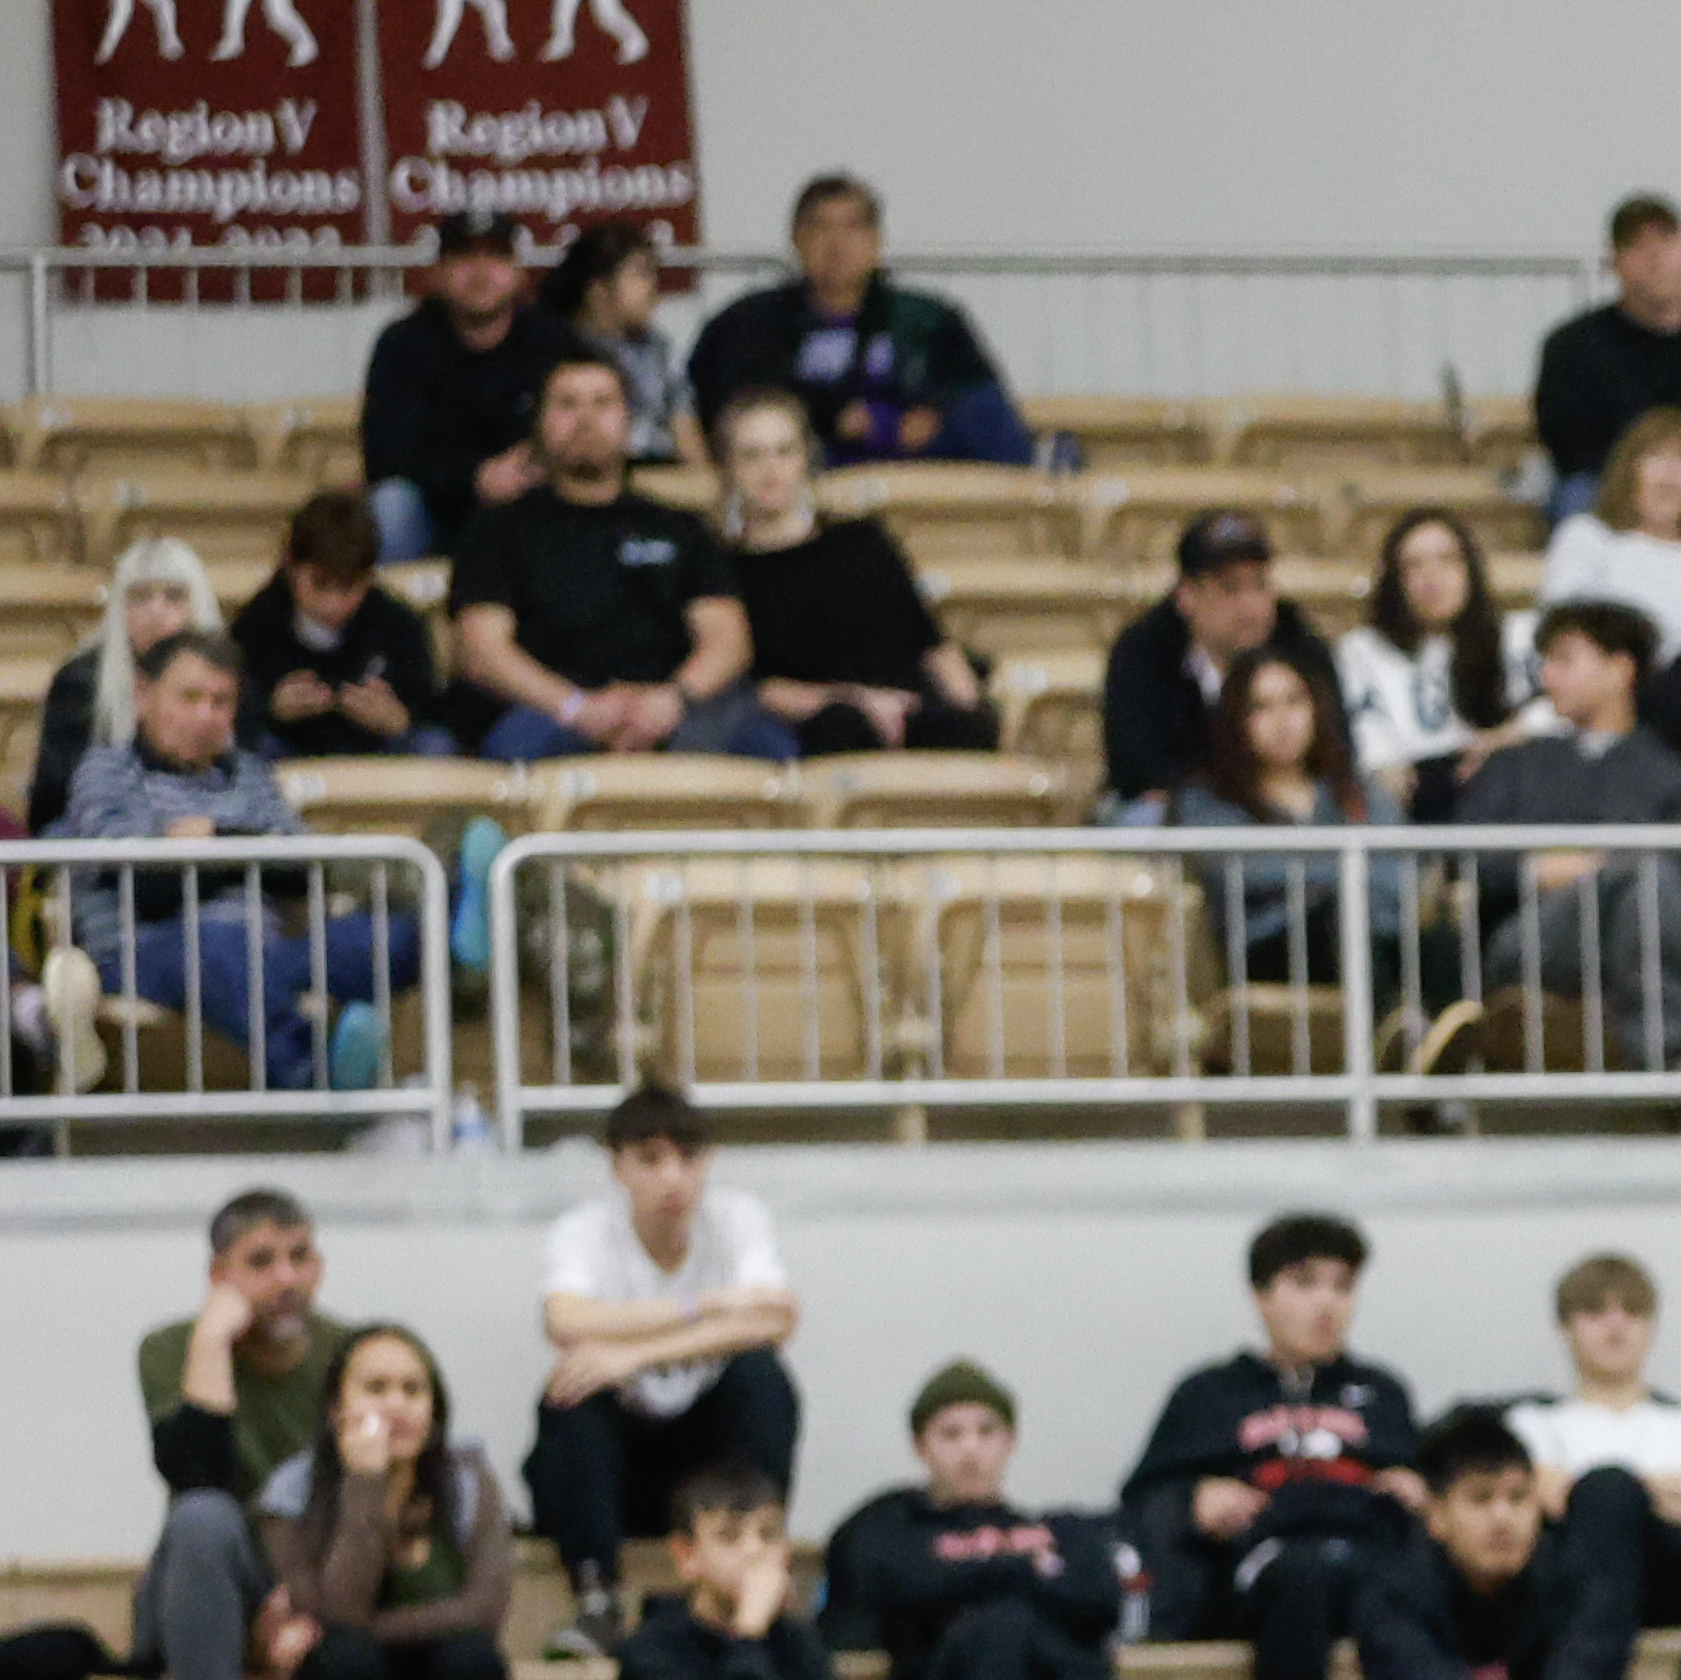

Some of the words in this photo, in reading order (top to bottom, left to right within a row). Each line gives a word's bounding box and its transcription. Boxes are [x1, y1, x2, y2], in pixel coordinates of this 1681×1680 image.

[97, 97, 275, 164] Region
[275, 97, 318, 153] V
[427, 98, 609, 165] Region
[608, 95, 648, 151] V
[62, 152, 360, 221] Champions
[390, 154, 694, 220] Champions
